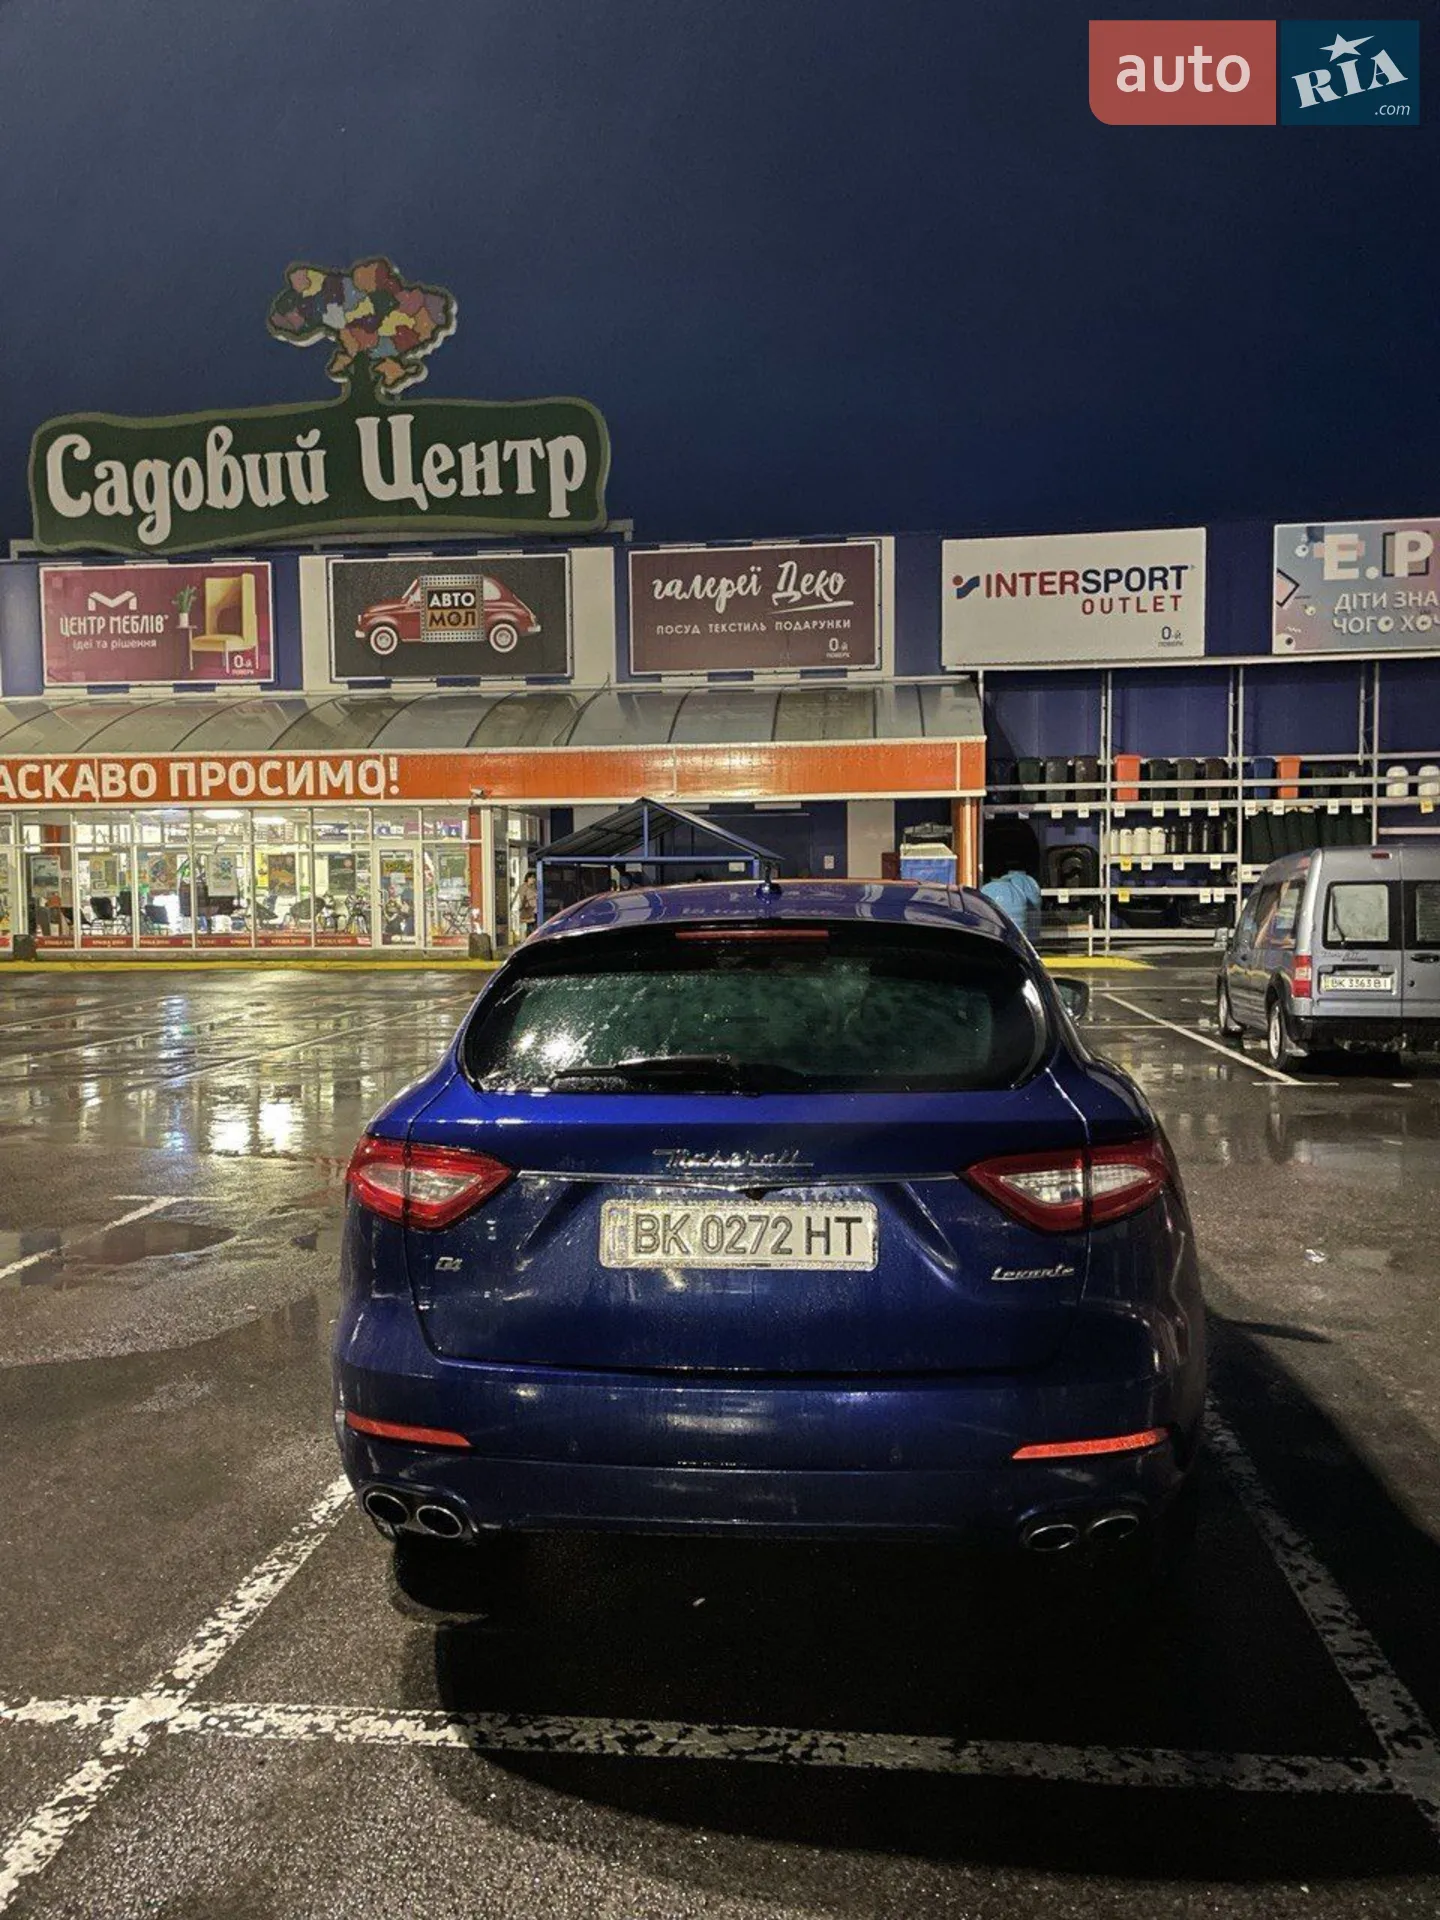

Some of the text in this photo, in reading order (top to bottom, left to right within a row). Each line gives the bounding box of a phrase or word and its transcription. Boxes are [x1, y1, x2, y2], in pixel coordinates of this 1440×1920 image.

[46, 414, 587, 545] Садовий Центр
[652, 560, 846, 614] галереї Деко
[985, 564, 1189, 599] INTERSPORT
[429, 592, 475, 607] АВТО
[1082, 595, 1182, 616] OUTLET
[1334, 590, 1438, 615] ДІТИ ЗНА
[59, 614, 106, 637] ЦЕНТР
[429, 611, 476, 627] МОЛ
[656, 619, 851, 635] ПОСУД ТЕКСТИЛЬ ПОДАРУНКИ
[97, 640, 108, 648] та
[111, 638, 157, 650] рішення
[169, 757, 400, 797] ПРОСИМО!
[633, 1214, 690, 1255] BK
[701, 1214, 793, 1255] 0272
[805, 1215, 863, 1257] HT
[991, 1263, 1075, 1281] Levante
